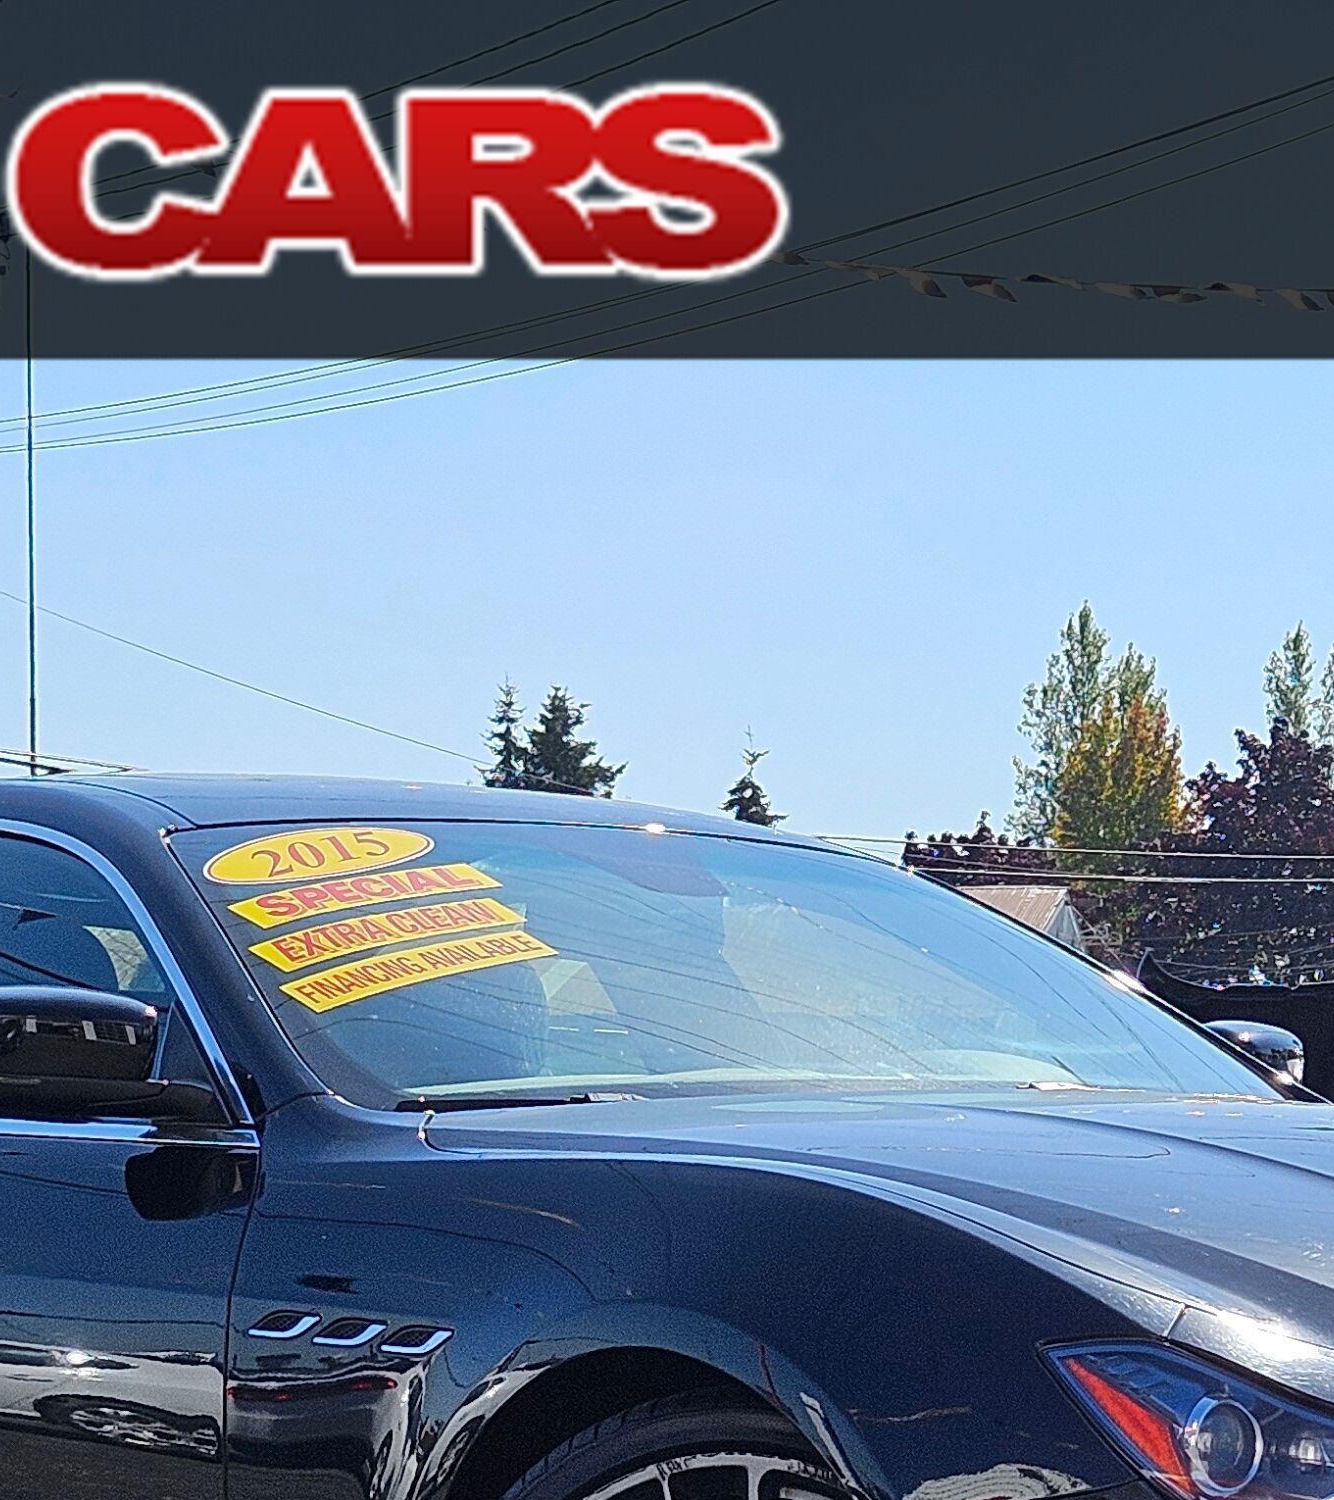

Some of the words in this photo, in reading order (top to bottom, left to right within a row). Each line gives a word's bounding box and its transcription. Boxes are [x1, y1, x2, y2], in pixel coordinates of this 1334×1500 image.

[252, 830, 391, 878] 2015
[255, 867, 474, 917] SPECIAL
[273, 918, 388, 962] EXTRA
[389, 901, 493, 933] CLEAN
[295, 956, 424, 1002] FINANCING
[426, 935, 542, 970] AVAILABLE
